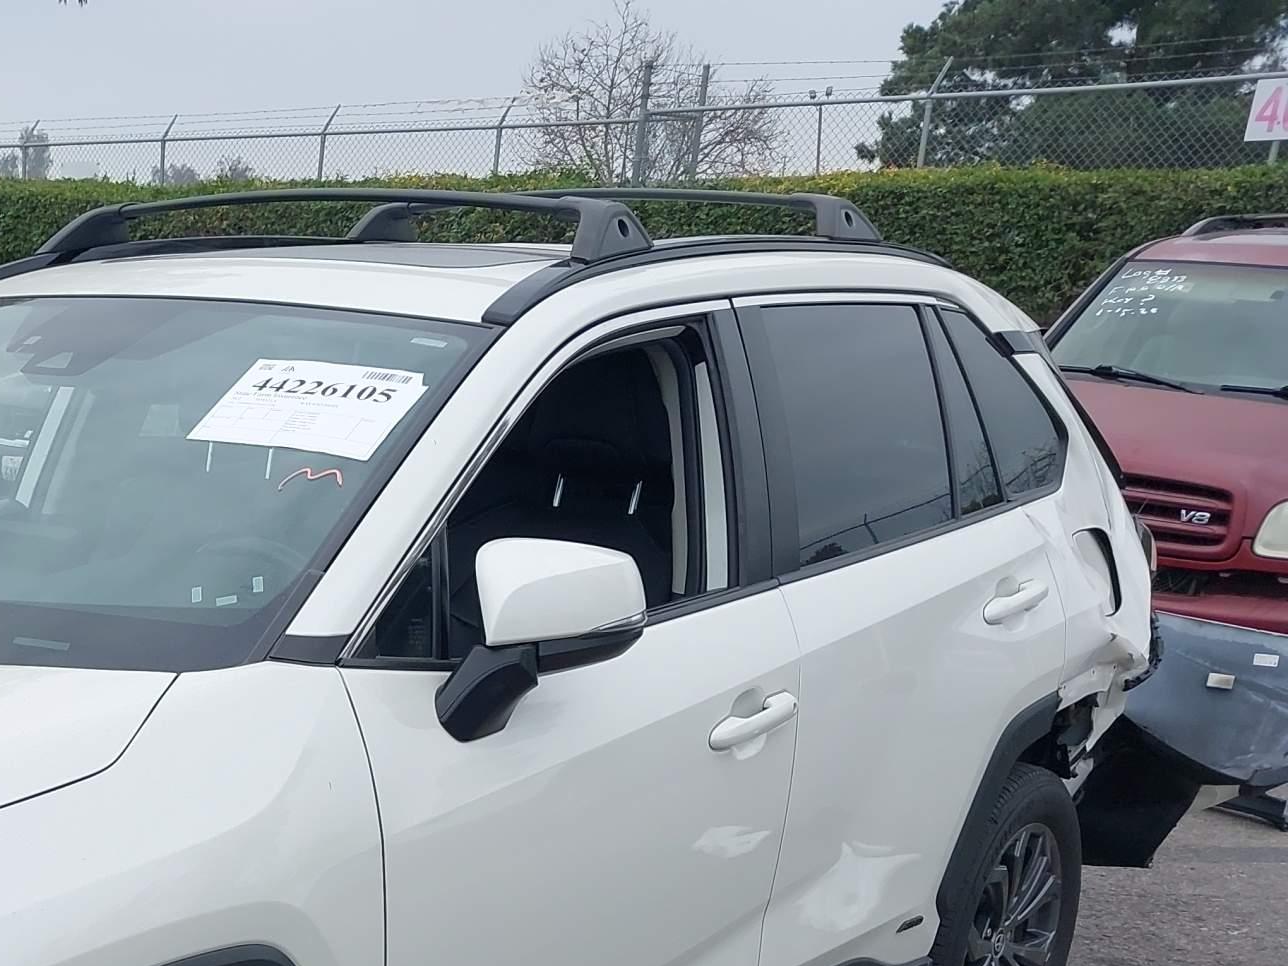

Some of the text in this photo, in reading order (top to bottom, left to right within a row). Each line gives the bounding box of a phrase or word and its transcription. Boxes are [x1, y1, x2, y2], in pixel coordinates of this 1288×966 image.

[1255, 86, 1288, 133] 4
[252, 376, 397, 403] 44226105
[1180, 509, 1211, 524] V8
